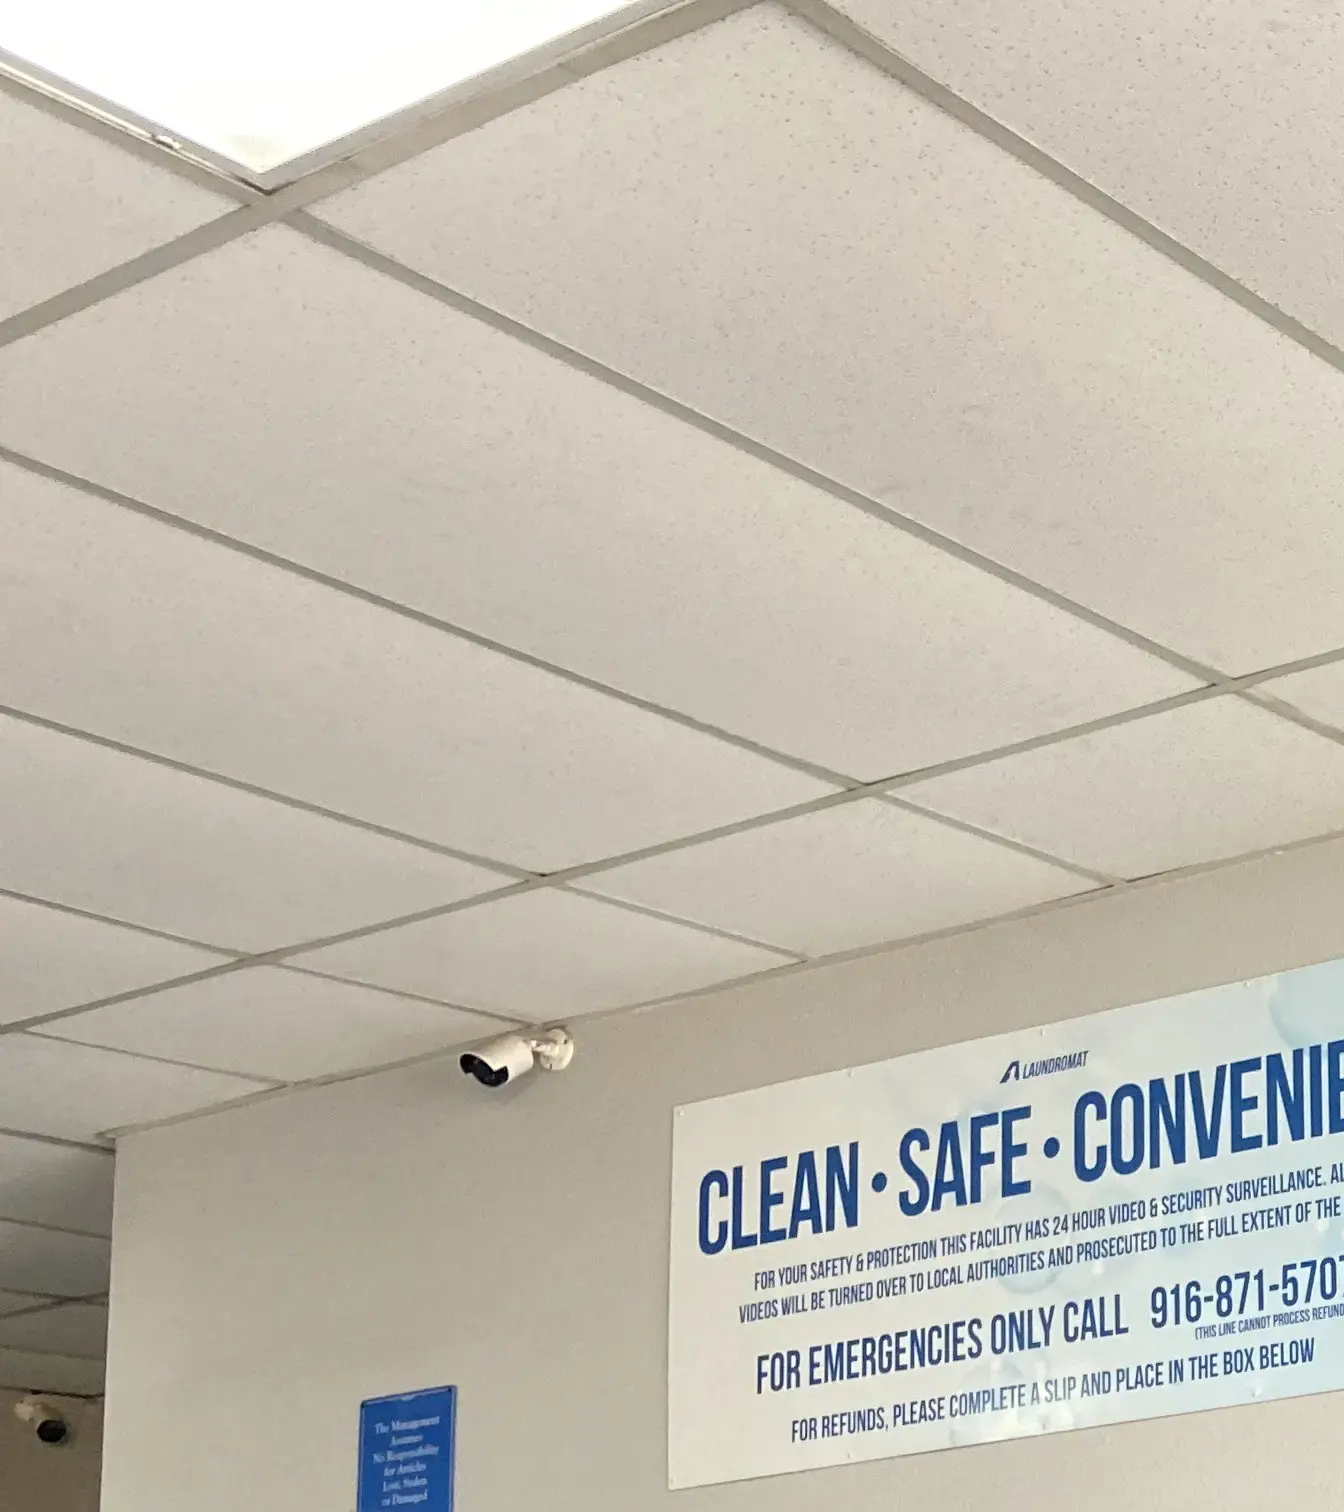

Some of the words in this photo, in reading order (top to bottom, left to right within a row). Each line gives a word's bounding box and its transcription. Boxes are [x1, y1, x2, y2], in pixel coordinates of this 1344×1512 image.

[1022, 1050, 1089, 1079] LAUNDROMAT
[698, 1141, 859, 1255] CLEAN
[899, 1105, 1032, 1217] SAFE
[754, 1271, 775, 1291] FOR
[778, 1264, 808, 1287] YOUR
[810, 1255, 853, 1282] SAFETY
[856, 1253, 864, 1272] &
[867, 1240, 937, 1270] PROTECTION
[940, 1234, 967, 1257] THIS
[969, 1223, 1022, 1252] FACILITY
[1025, 1218, 1051, 1241] HAS
[1053, 1216, 1069, 1235] 24
[1072, 1208, 1106, 1232] HOUR
[1109, 1201, 1146, 1225] VIDEO
[1149, 1198, 1158, 1217] &
[1161, 1185, 1223, 1215] SECURITY
[1226, 1166, 1327, 1203] SURVEILLANCE.
[739, 1301, 778, 1324] VIDEOS
[781, 1295, 808, 1317] WILL
[810, 1291, 825, 1311] BE
[828, 1282, 874, 1308] TURNED
[876, 1277, 907, 1298] OVER
[909, 1273, 924, 1293] TO
[927, 1265, 964, 1290] LOCAL
[966, 1251, 1045, 1283] AUTHORITIES
[1048, 1246, 1073, 1269] AND
[1076, 1230, 1157, 1263] PROSECUTED
[1160, 1226, 1176, 1248] TO
[1180, 1221, 1205, 1244] THE
[1208, 1215, 1239, 1239] FULL
[1242, 1205, 1292, 1233] EXTENT
[1295, 1202, 1313, 1224] OF
[1316, 1197, 1341, 1219] THE
[756, 1350, 801, 1395] FOR
[808, 1318, 983, 1386] EMERGENCIES
[990, 1305, 1055, 1356] ONLY
[1063, 1293, 1129, 1343] CALL
[1218, 1318, 1237, 1337] LINE
[1238, 1315, 1271, 1334] CANNOT
[1273, 1308, 1311, 1329] PROCESS
[792, 1419, 817, 1443] FOR
[821, 1407, 889, 1439] REFUNDS,
[892, 1396, 945, 1428] PLEASE
[949, 1383, 1026, 1418] COMPLETE
[1030, 1382, 1041, 1405] A
[1044, 1376, 1077, 1402] SLIP
[1080, 1369, 1111, 1399] AND
[1116, 1360, 1164, 1392] PLACE
[1169, 1358, 1184, 1384] IN
[1188, 1352, 1219, 1380] THE
[1223, 1346, 1255, 1374] BOX
[1259, 1337, 1315, 1370] BELOW
